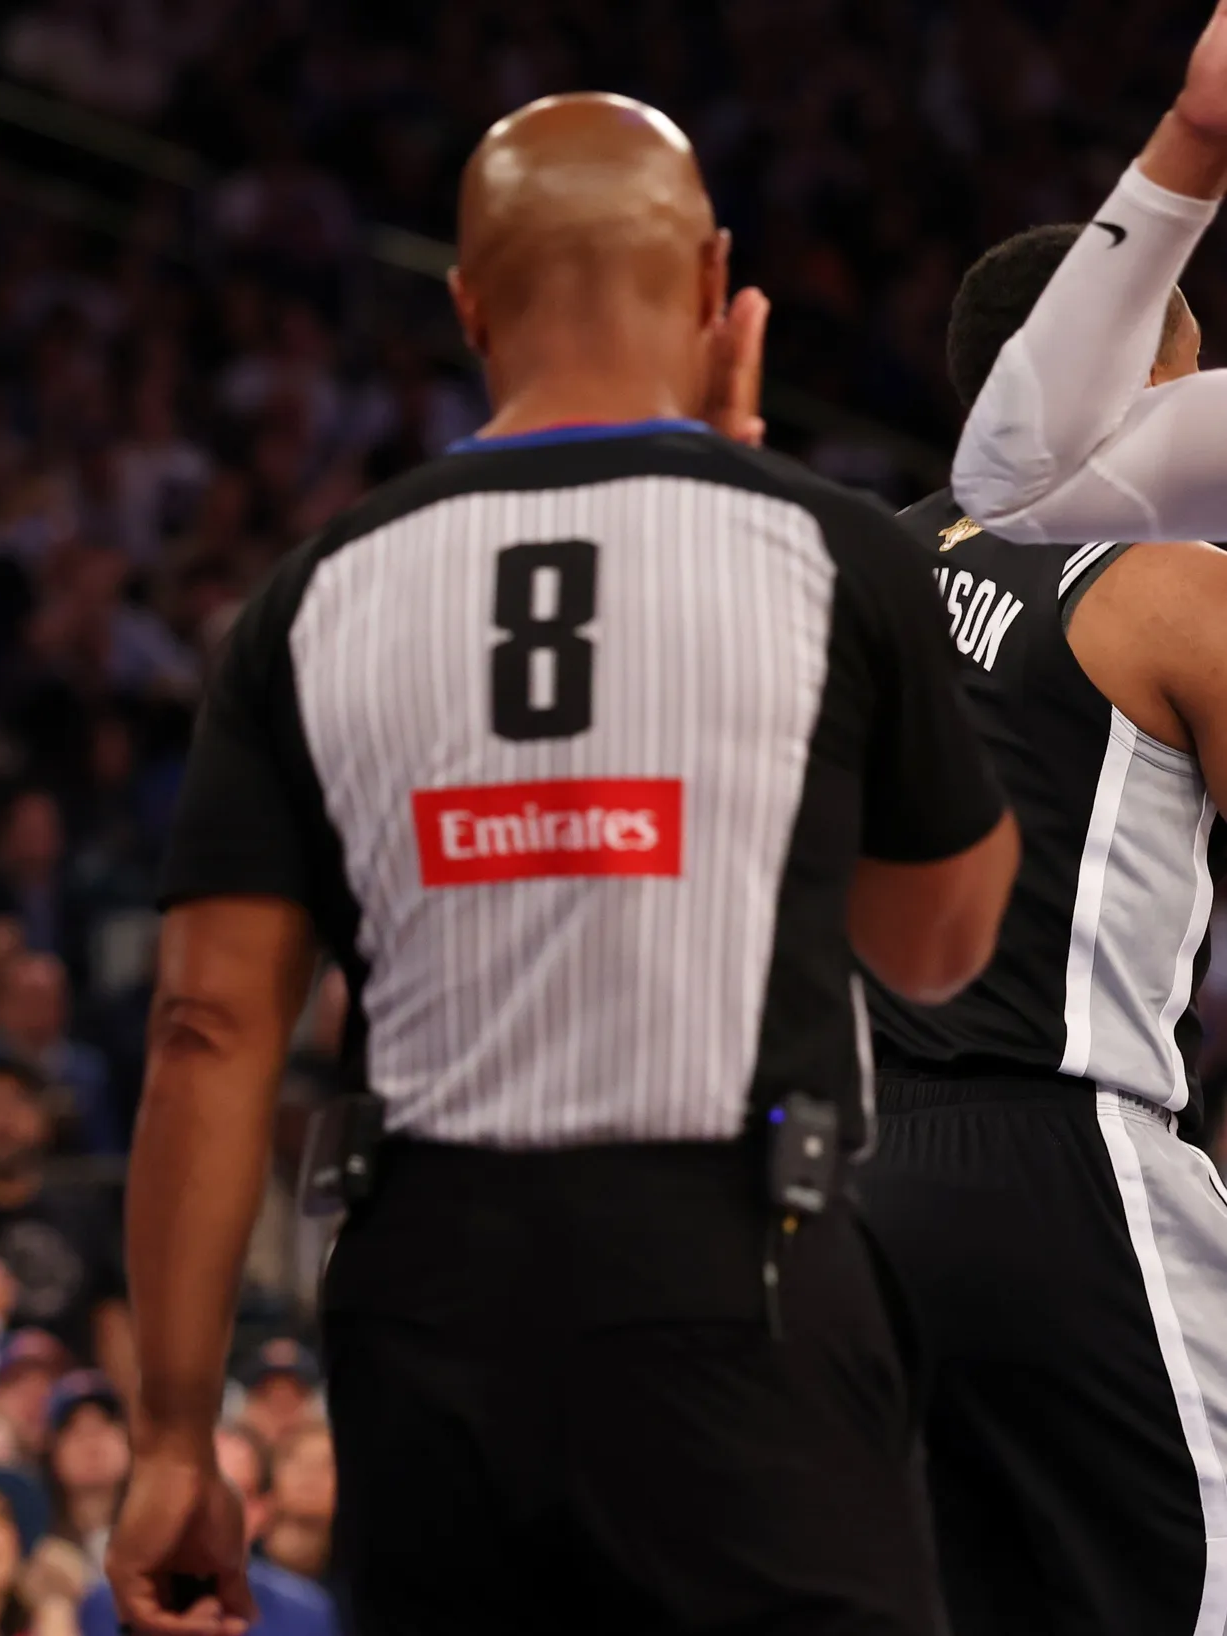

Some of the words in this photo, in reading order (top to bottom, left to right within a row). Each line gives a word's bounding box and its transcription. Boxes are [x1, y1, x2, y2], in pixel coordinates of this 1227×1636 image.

[491, 538, 599, 743] 8
[932, 567, 1024, 672] SON
[438, 802, 659, 861] Emirates
